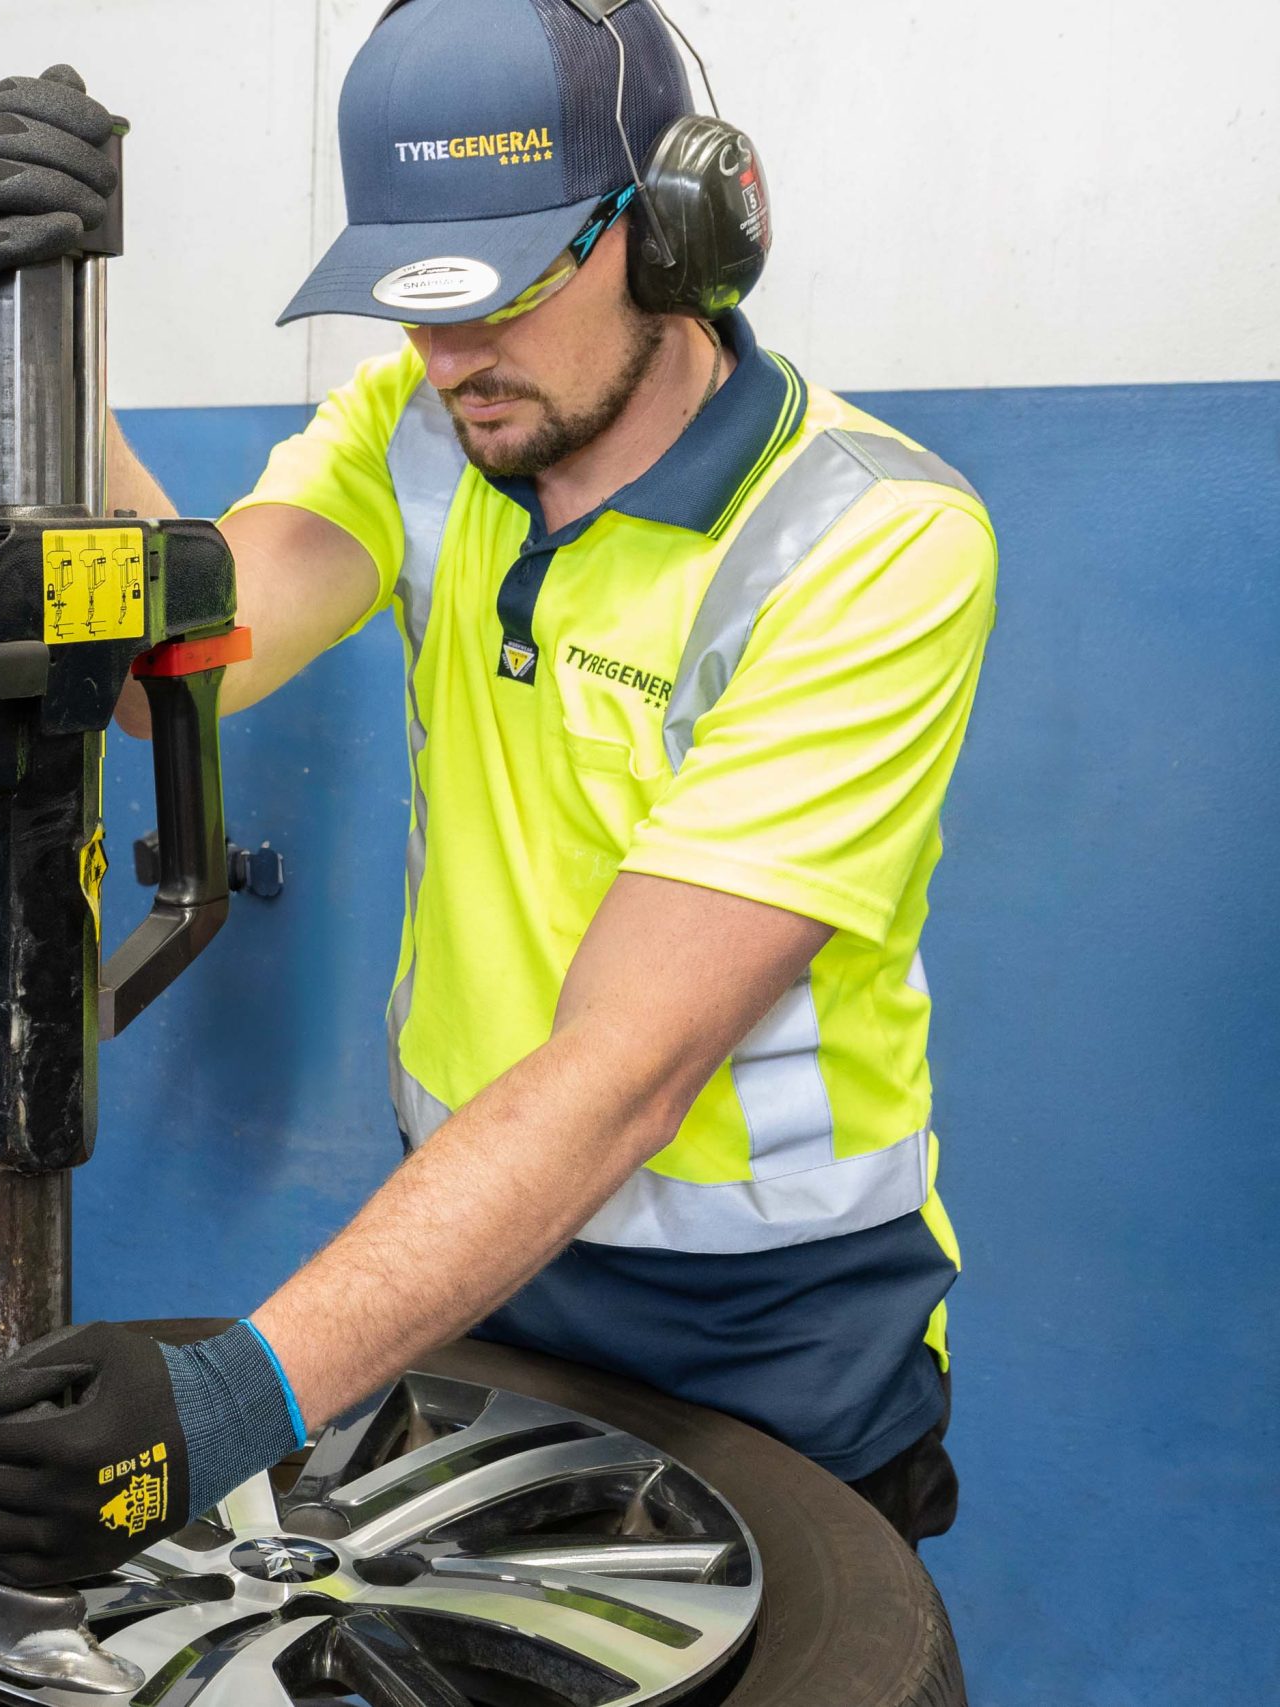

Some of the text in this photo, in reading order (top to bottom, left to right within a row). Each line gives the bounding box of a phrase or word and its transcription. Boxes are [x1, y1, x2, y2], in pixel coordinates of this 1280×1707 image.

[395, 127, 553, 162] TYREGENERAL
[565, 645, 672, 701] TYREGENER
[131, 1478, 145, 1530] Black
[146, 1481, 158, 1518] Bull
